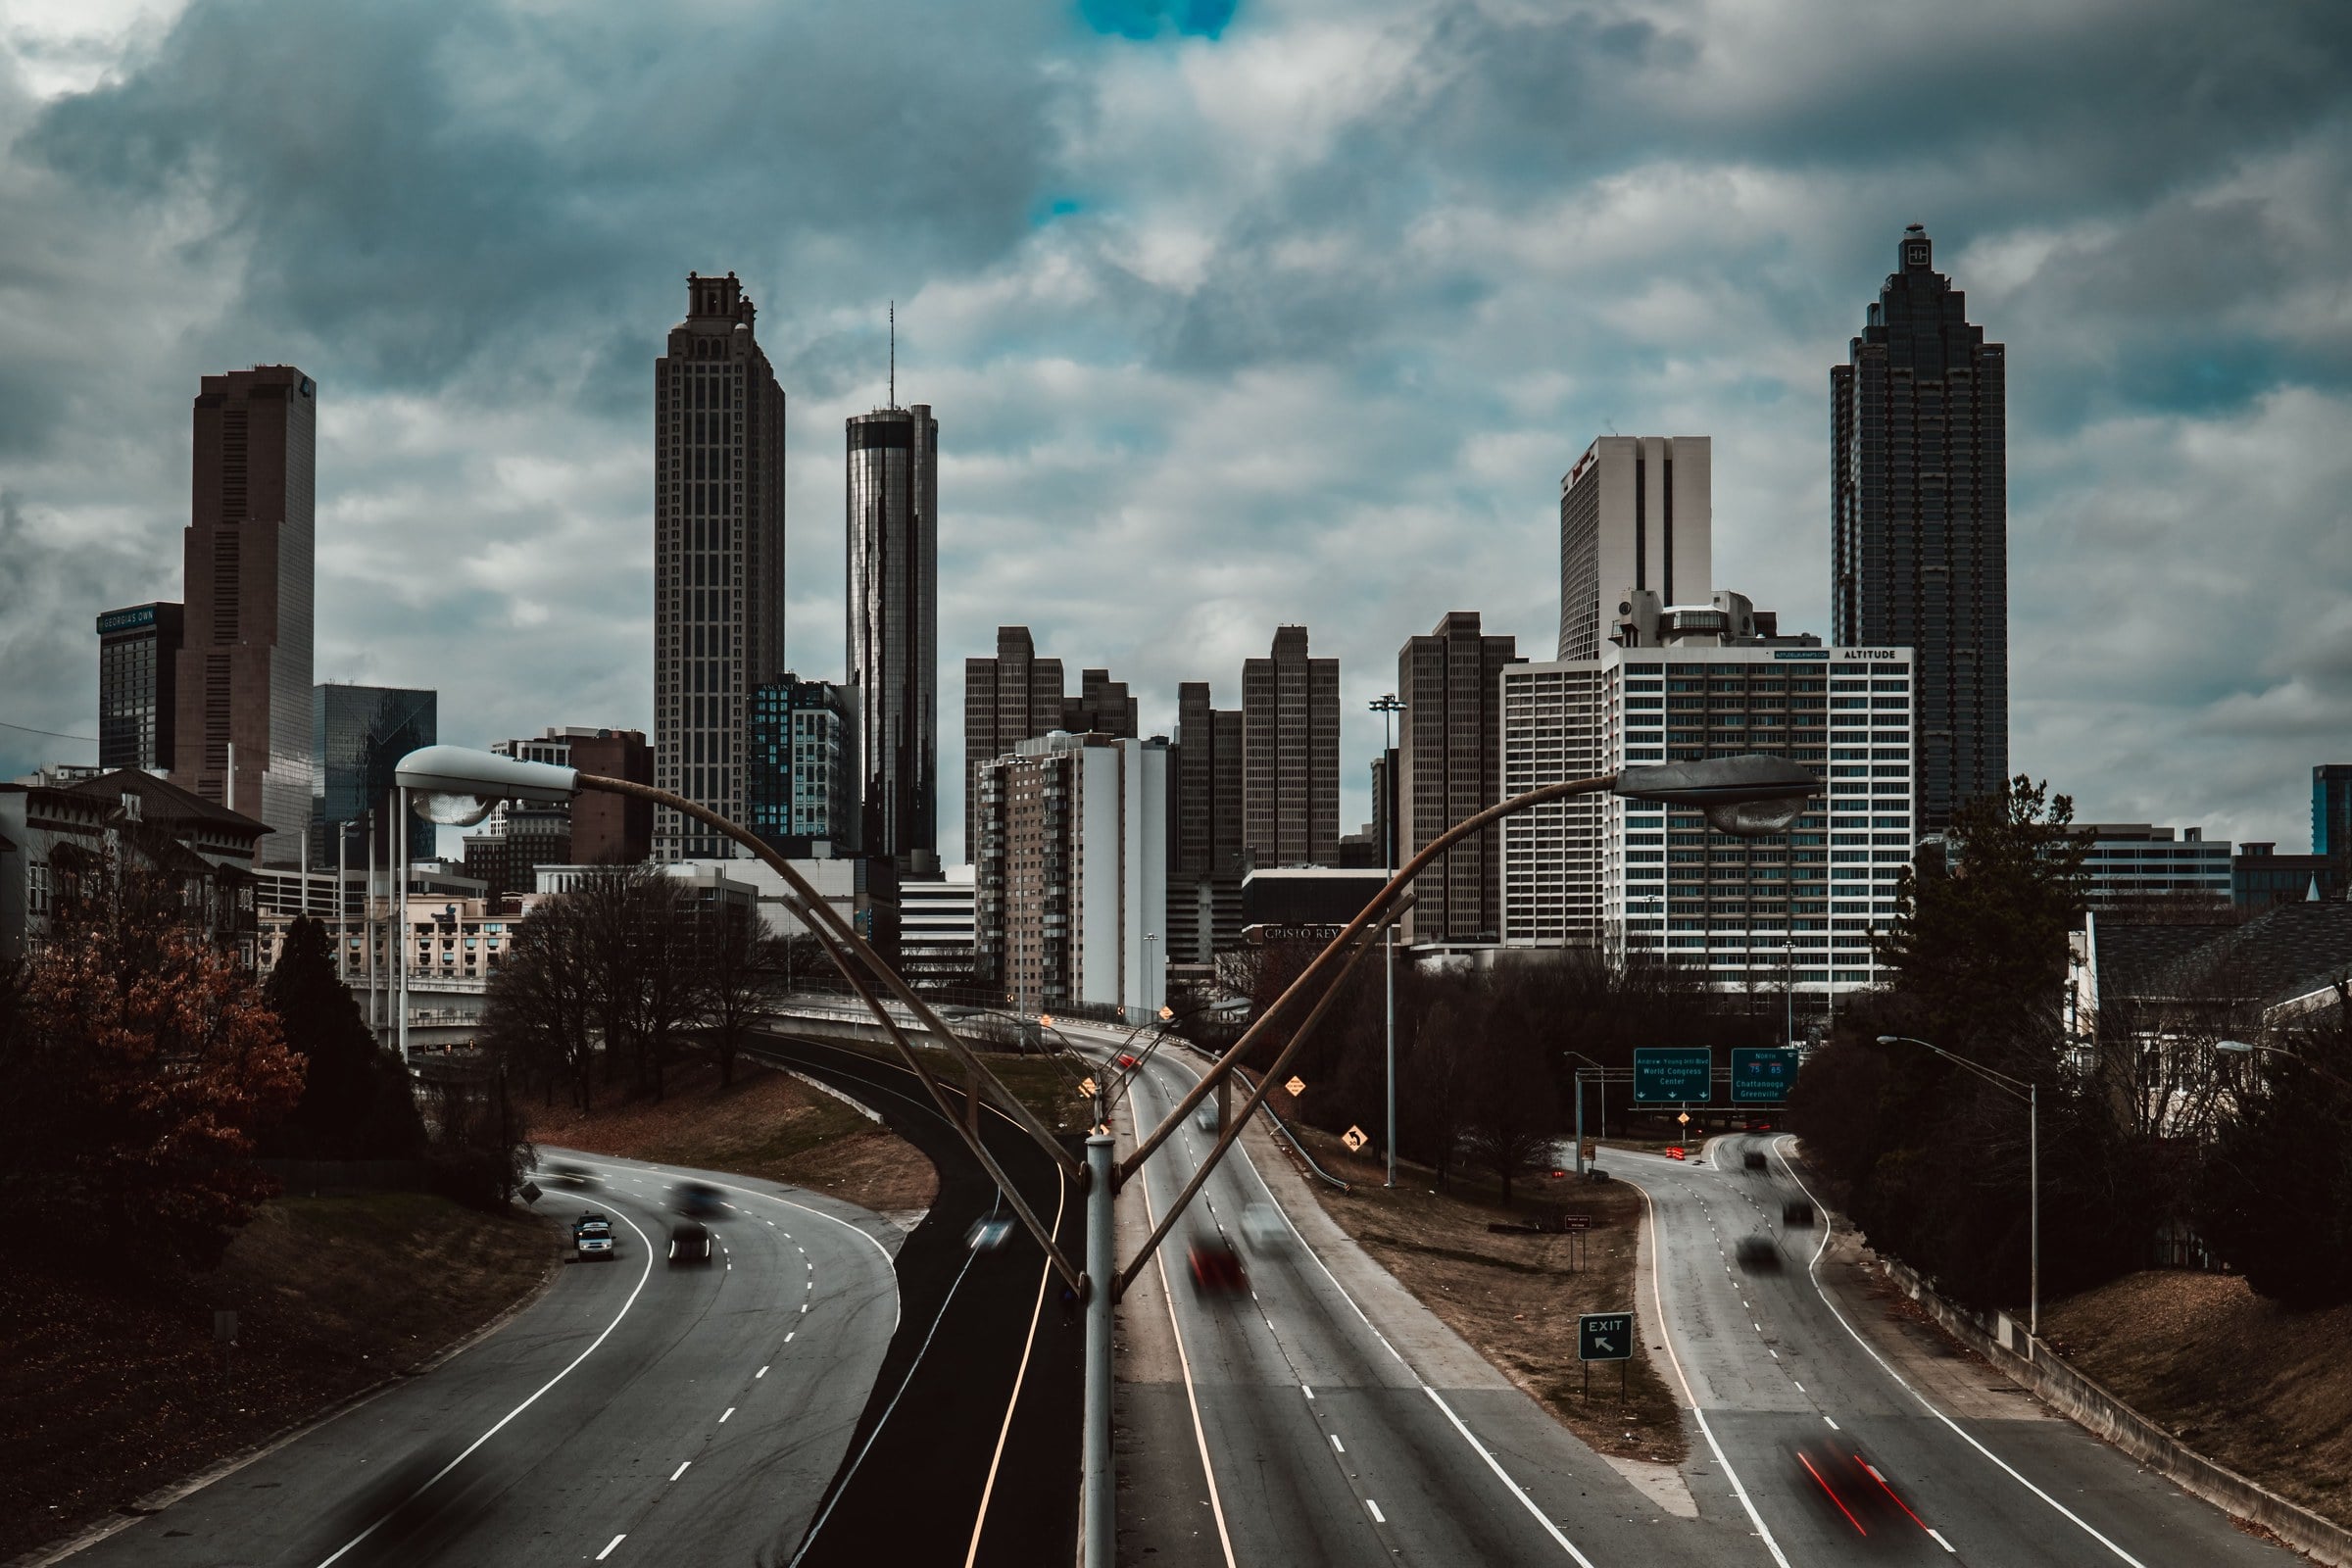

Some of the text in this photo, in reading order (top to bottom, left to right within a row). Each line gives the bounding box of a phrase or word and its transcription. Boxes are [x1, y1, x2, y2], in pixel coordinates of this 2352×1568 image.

[138, 610, 153, 621] OWN
[1844, 650, 1895, 659] ALTITUDE
[1264, 928, 1339, 939] CRISTO REY
[1667, 1067, 1701, 1076] Congress
[1589, 1320, 1623, 1332] EXIT
